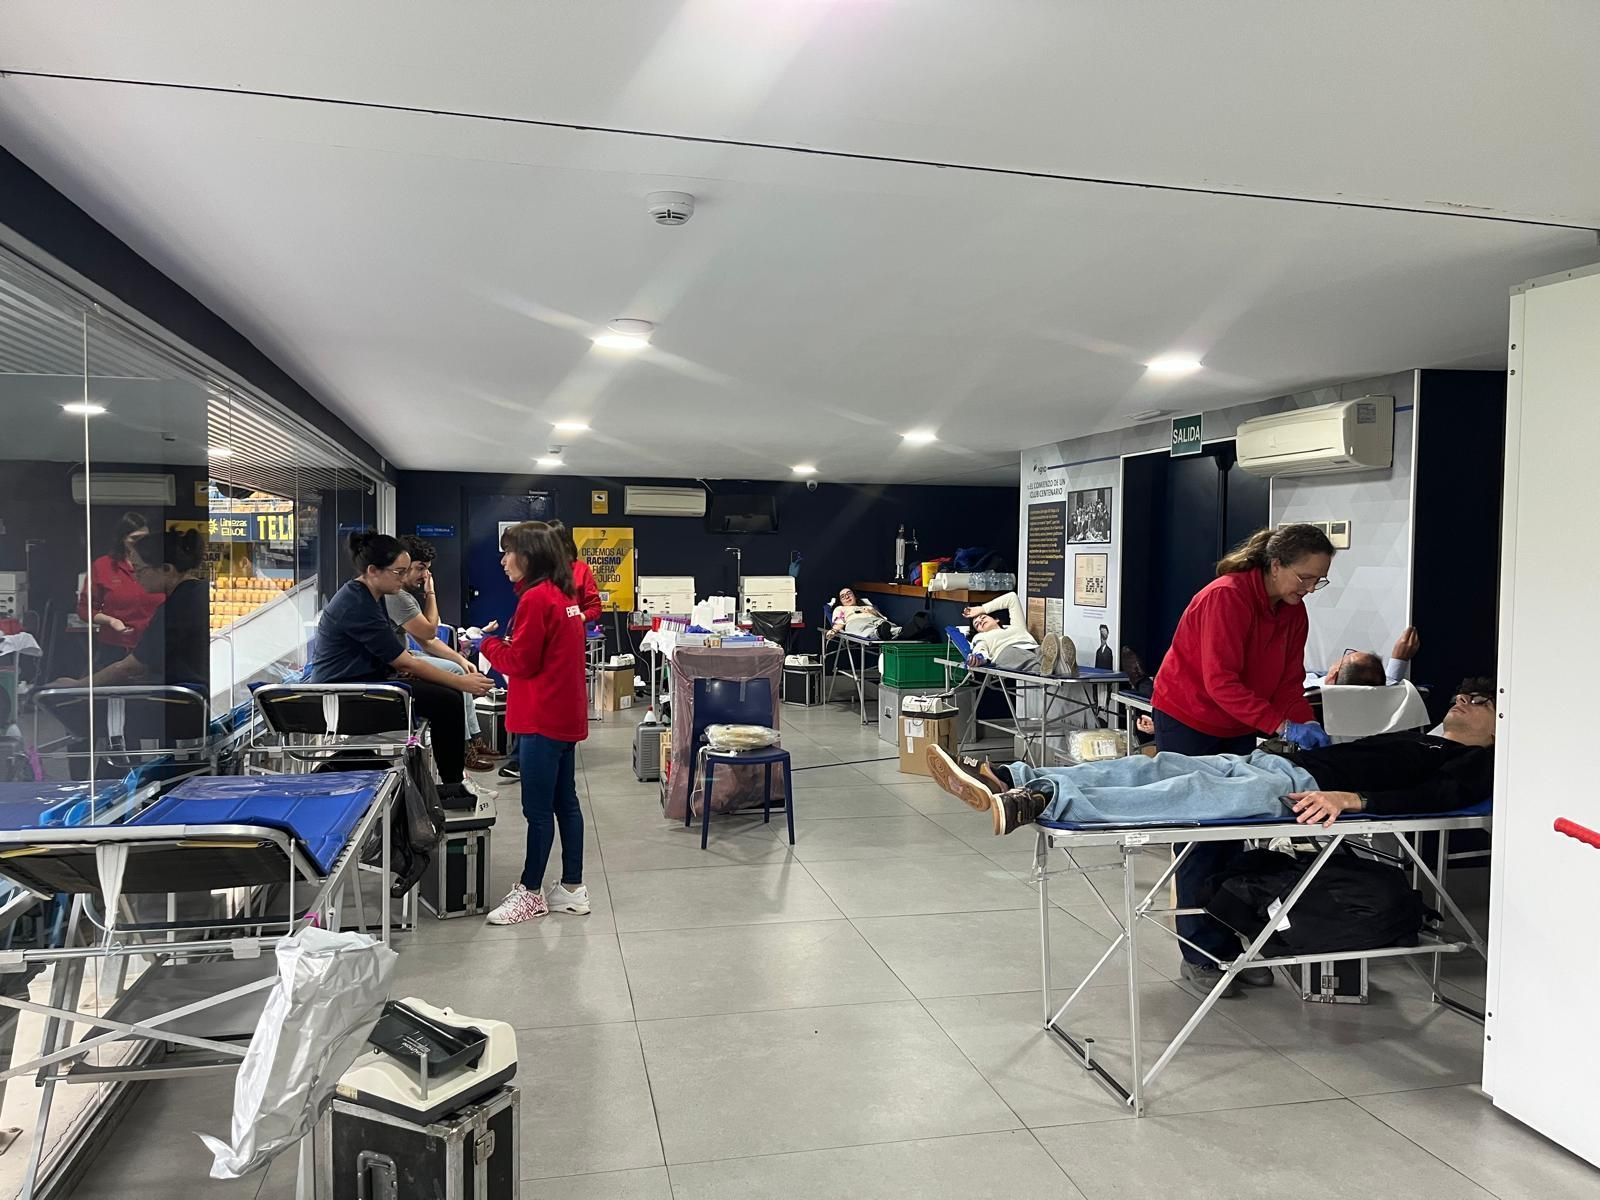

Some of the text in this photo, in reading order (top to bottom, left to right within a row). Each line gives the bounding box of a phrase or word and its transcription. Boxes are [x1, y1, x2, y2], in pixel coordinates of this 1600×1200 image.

[1173, 426, 1200, 444] SALIDA
[581, 547, 625, 556] DEJEMOS AL
[587, 557, 621, 565] RACISMO
[593, 565, 615, 574] FUERA
[598, 574, 620, 582] JUEGO
